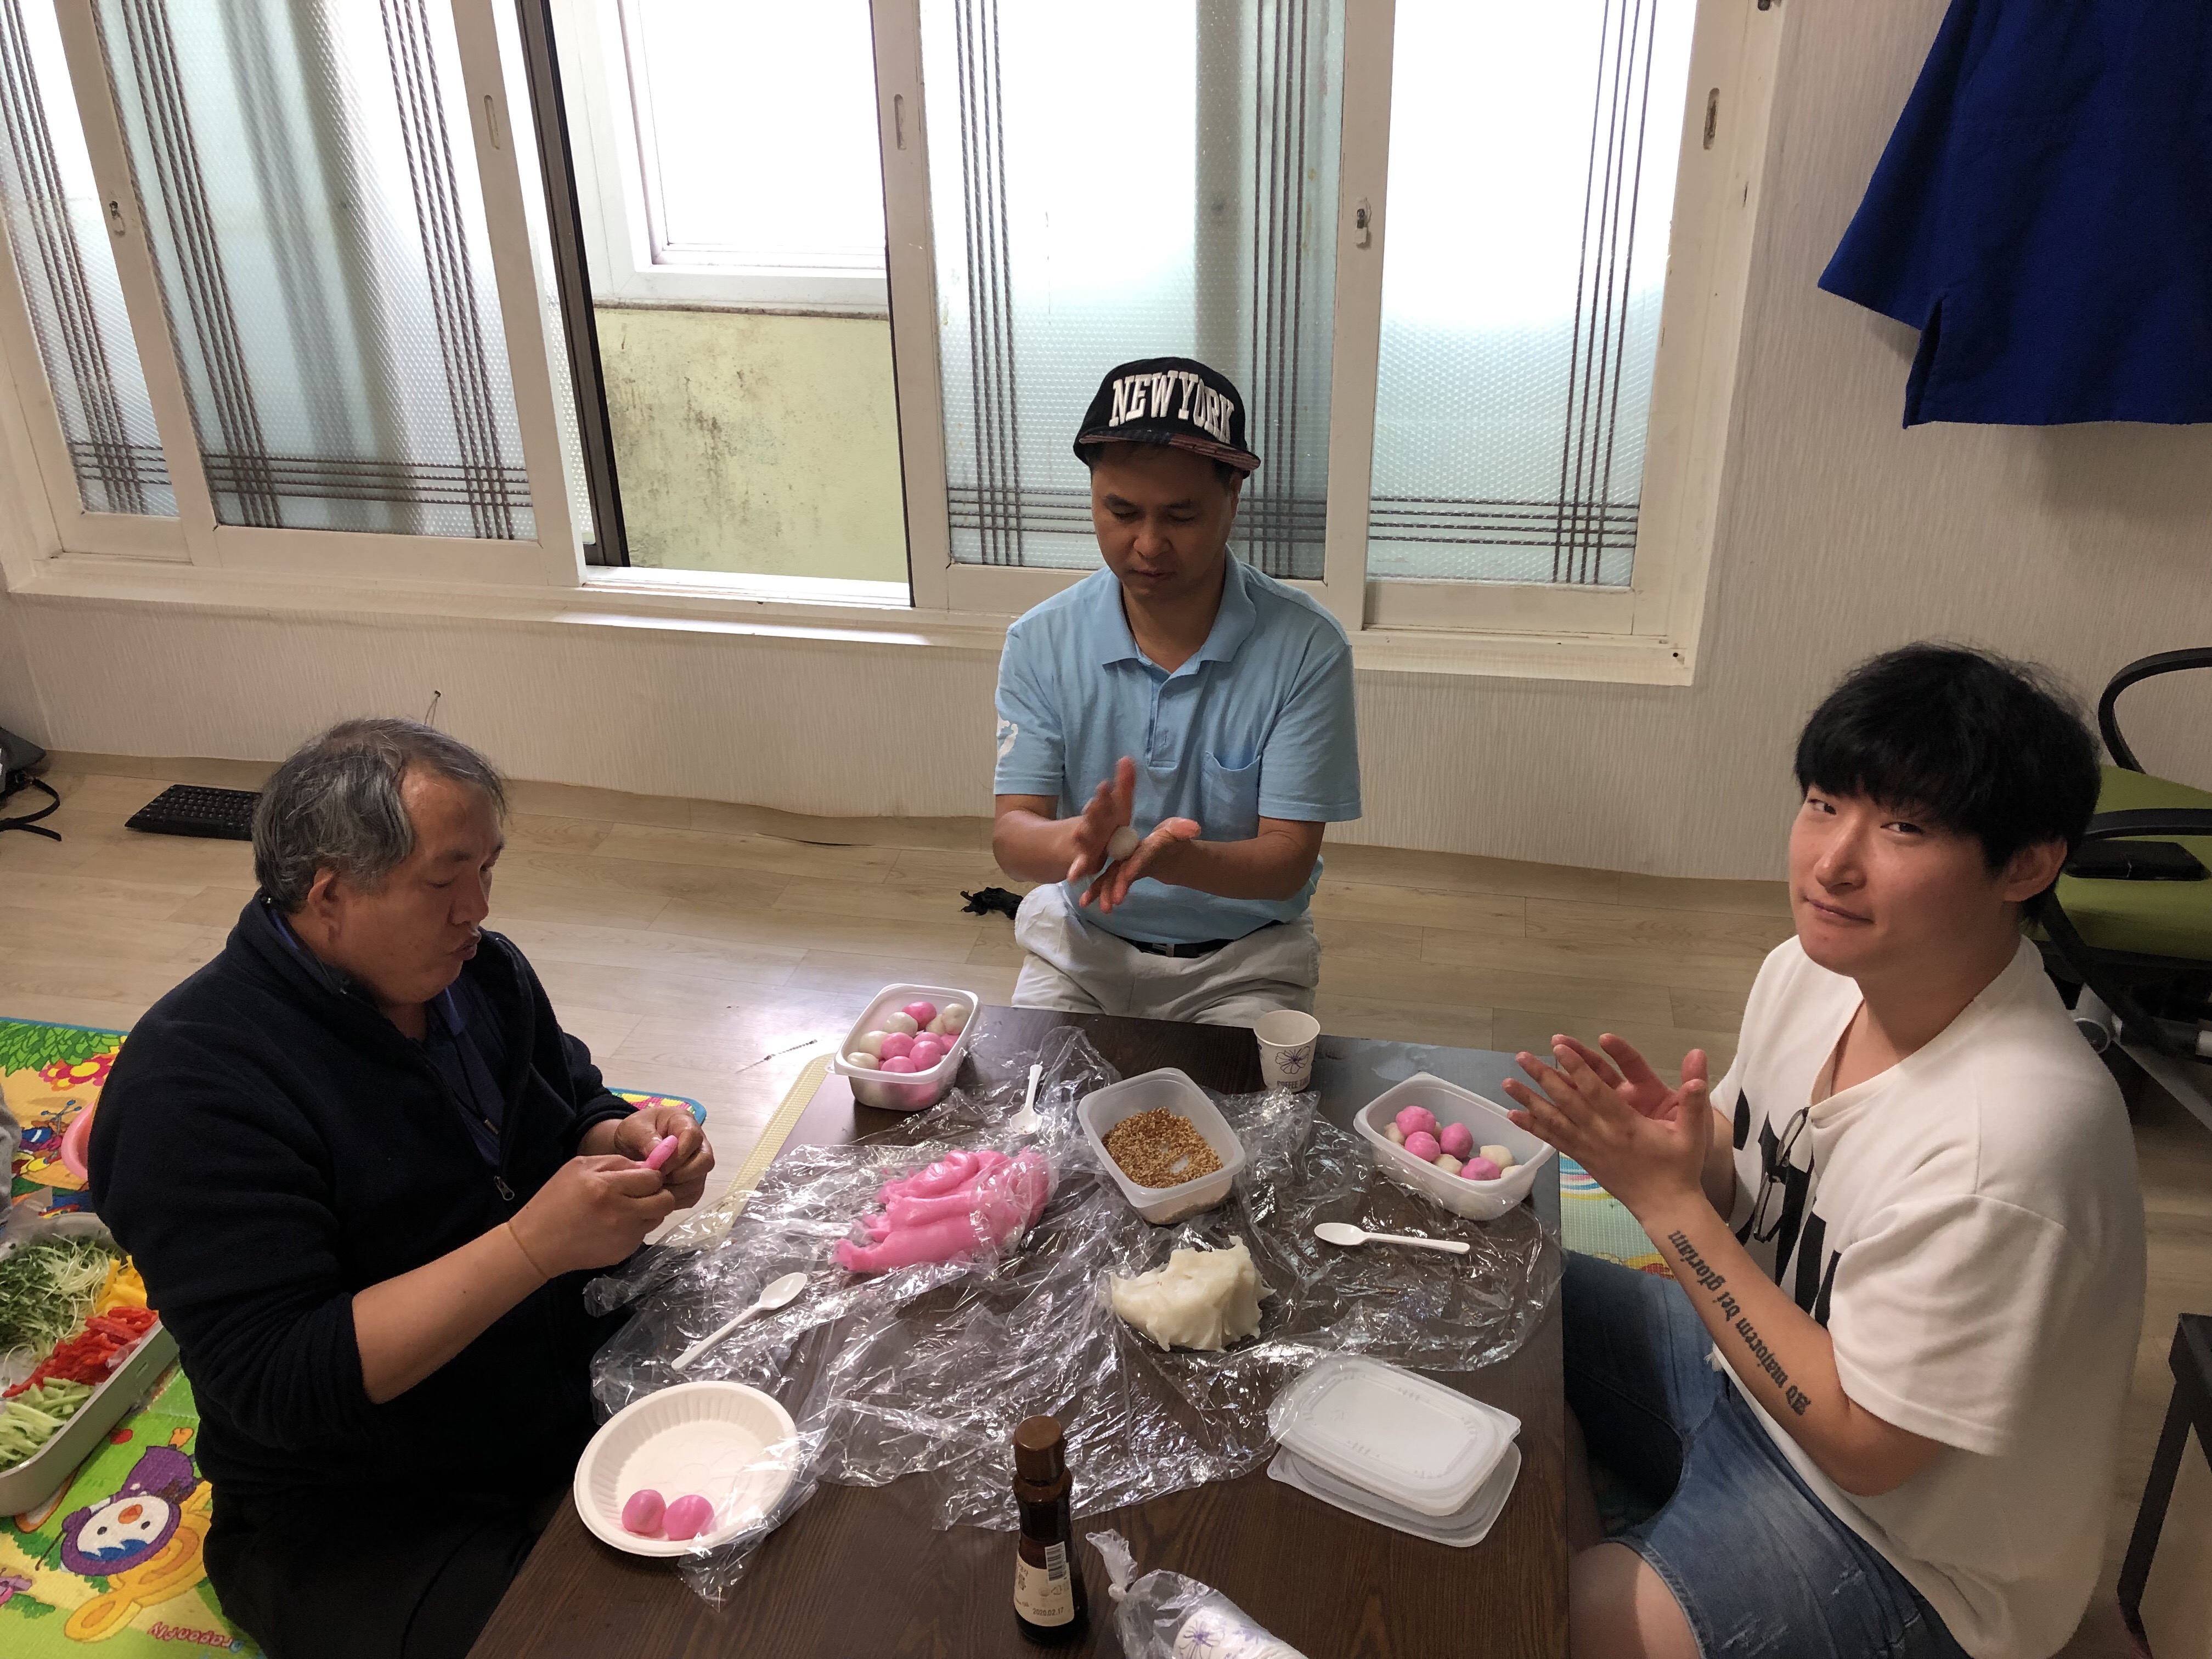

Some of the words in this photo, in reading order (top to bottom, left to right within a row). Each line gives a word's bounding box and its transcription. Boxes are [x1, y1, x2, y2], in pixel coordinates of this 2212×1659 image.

[1277, 1080, 1298, 1089] COFFEE
[1668, 1230, 1726, 1291] gloriam
[1712, 1291, 1741, 1322] dei
[1735, 1318, 1788, 1389] majorem
[1033, 1606, 1064, 1616] 2020.02.17
